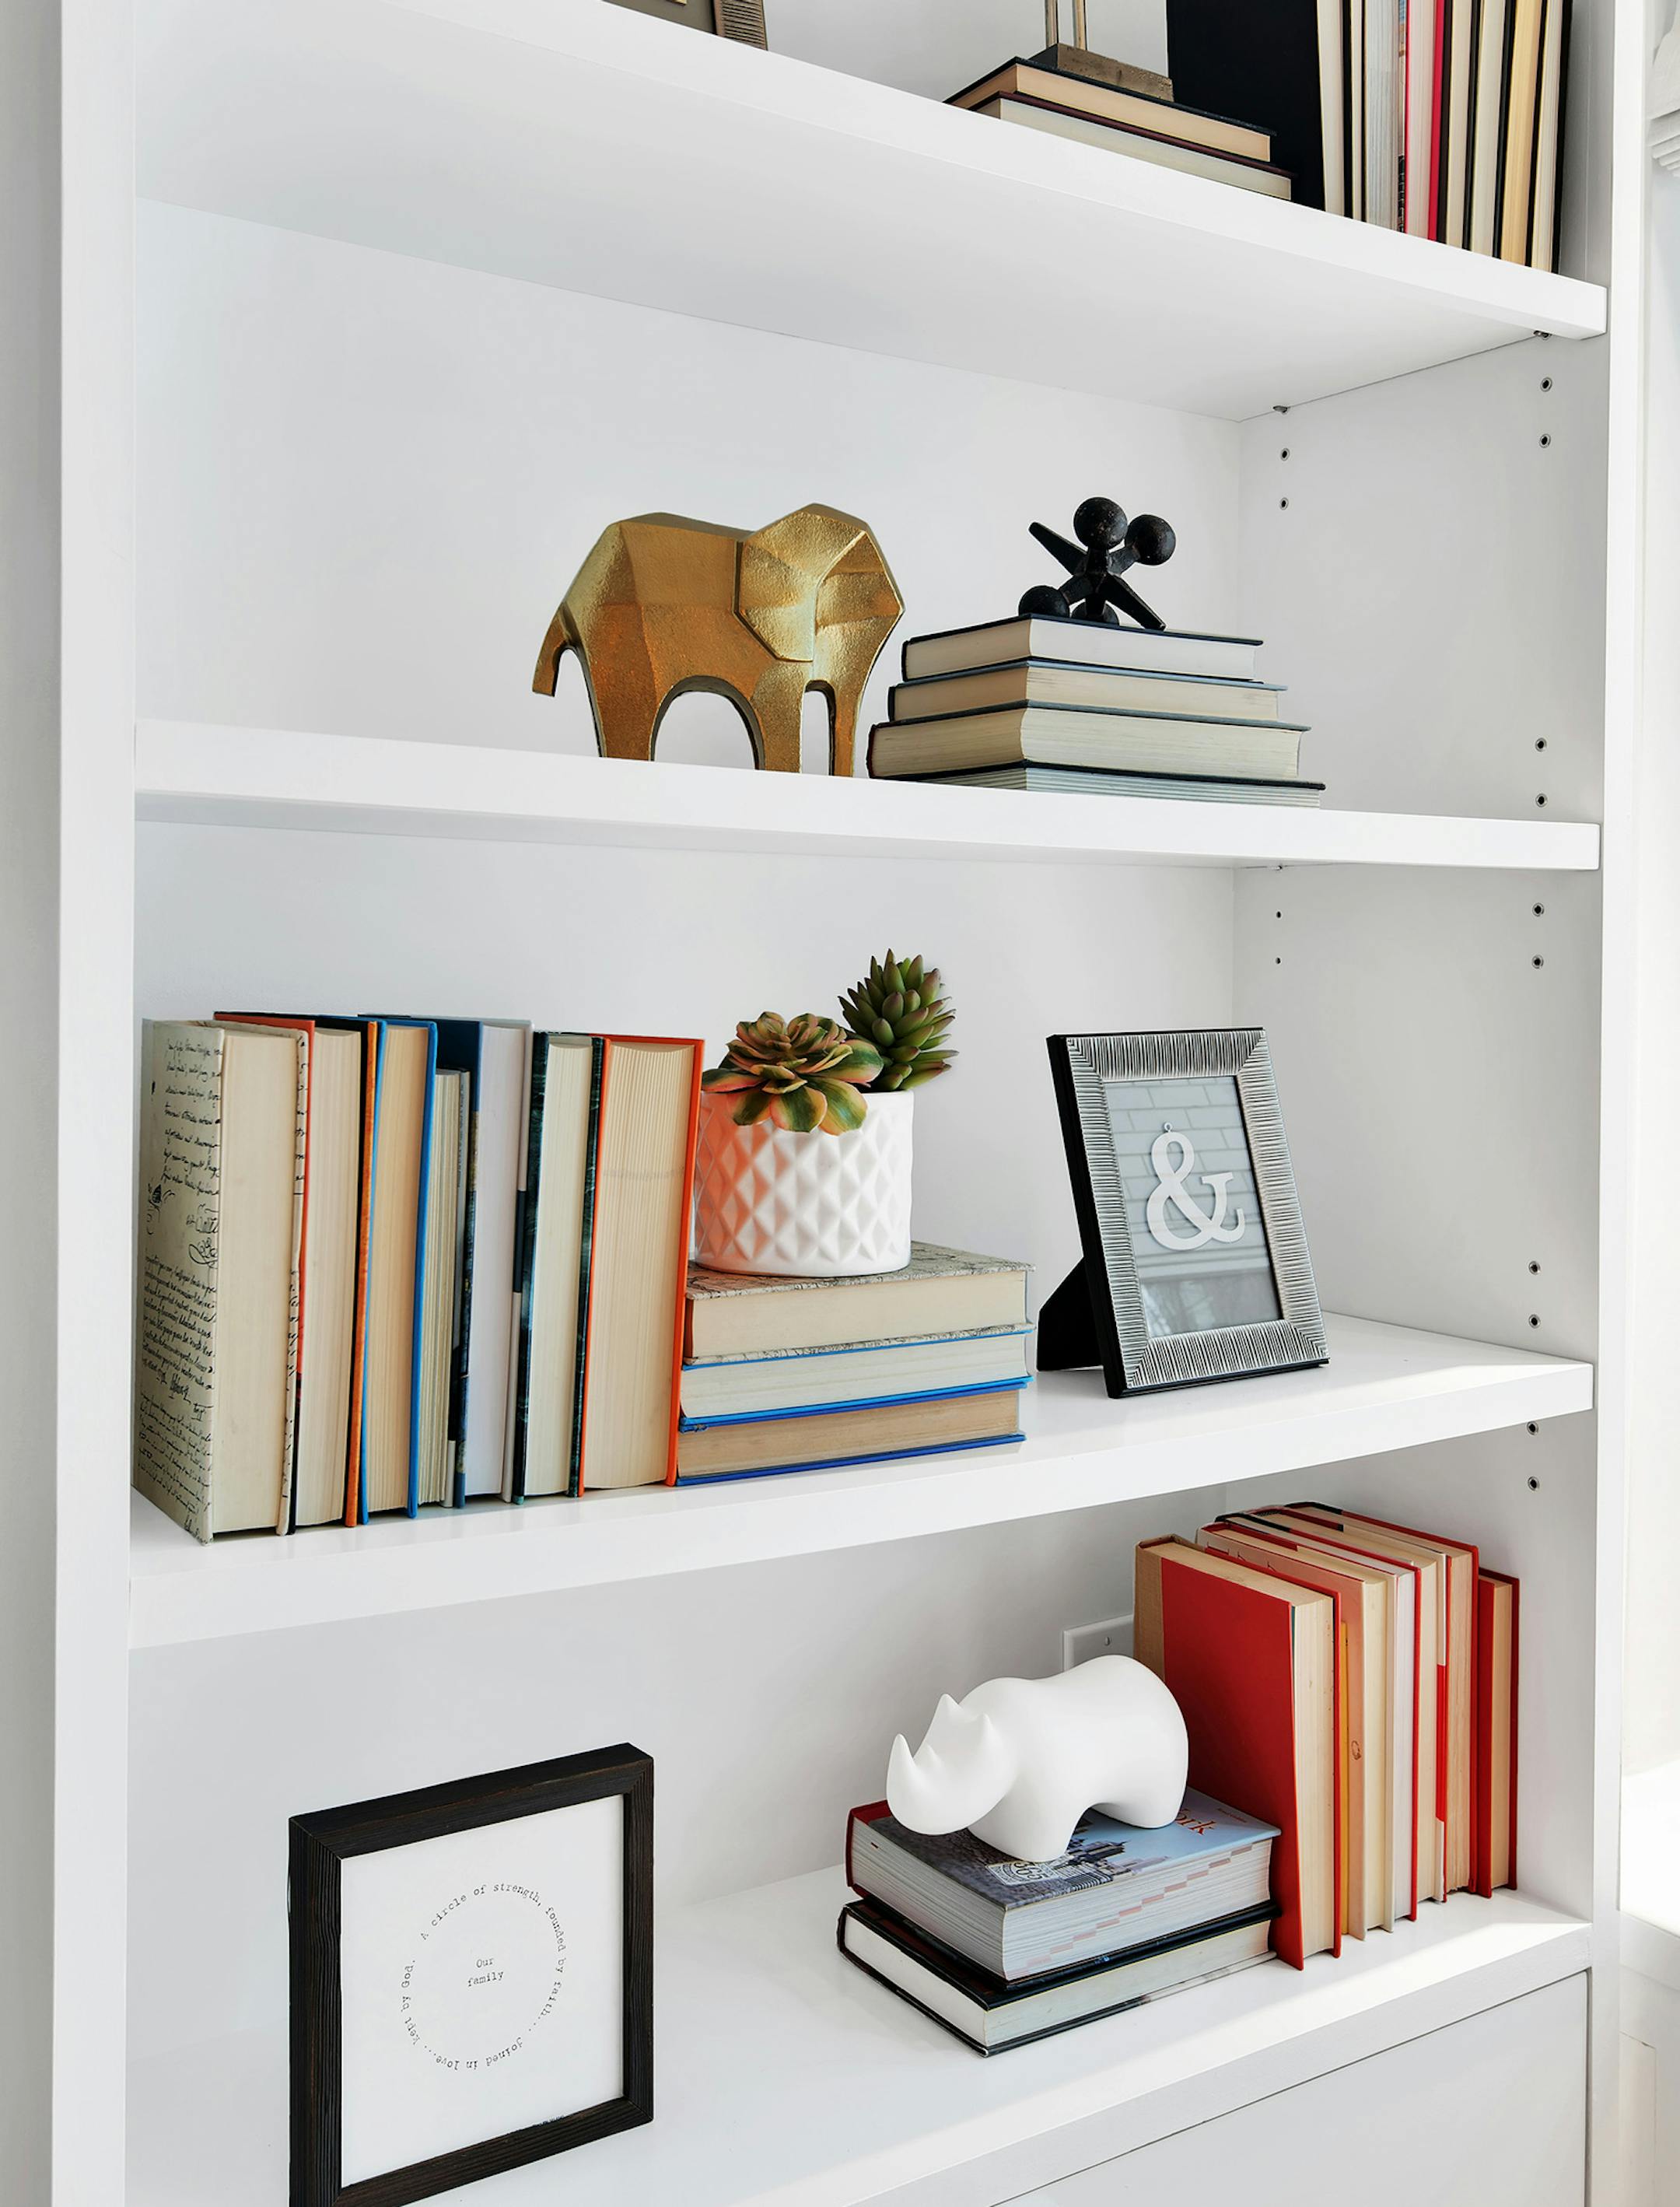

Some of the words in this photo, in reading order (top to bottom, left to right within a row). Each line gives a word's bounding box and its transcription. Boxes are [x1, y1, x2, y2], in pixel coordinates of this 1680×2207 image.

[1146, 1123, 1245, 1251] &
[1175, 1808, 1216, 1835] ork
[473, 1884, 487, 1896] of
[492, 1883, 541, 1907] strength,
[432, 1894, 467, 1927] circle
[420, 1932, 429, 1942] A
[544, 1906, 567, 1953] founded
[401, 1960, 416, 1988] God.
[476, 1957, 494, 1968] Our
[555, 1957, 567, 1974] by
[467, 1971, 504, 1988] family
[400, 1995, 411, 2013] by
[404, 2016, 421, 2046] kept
[485, 2037, 523, 2067] joined
[466, 2059, 478, 2071] in
